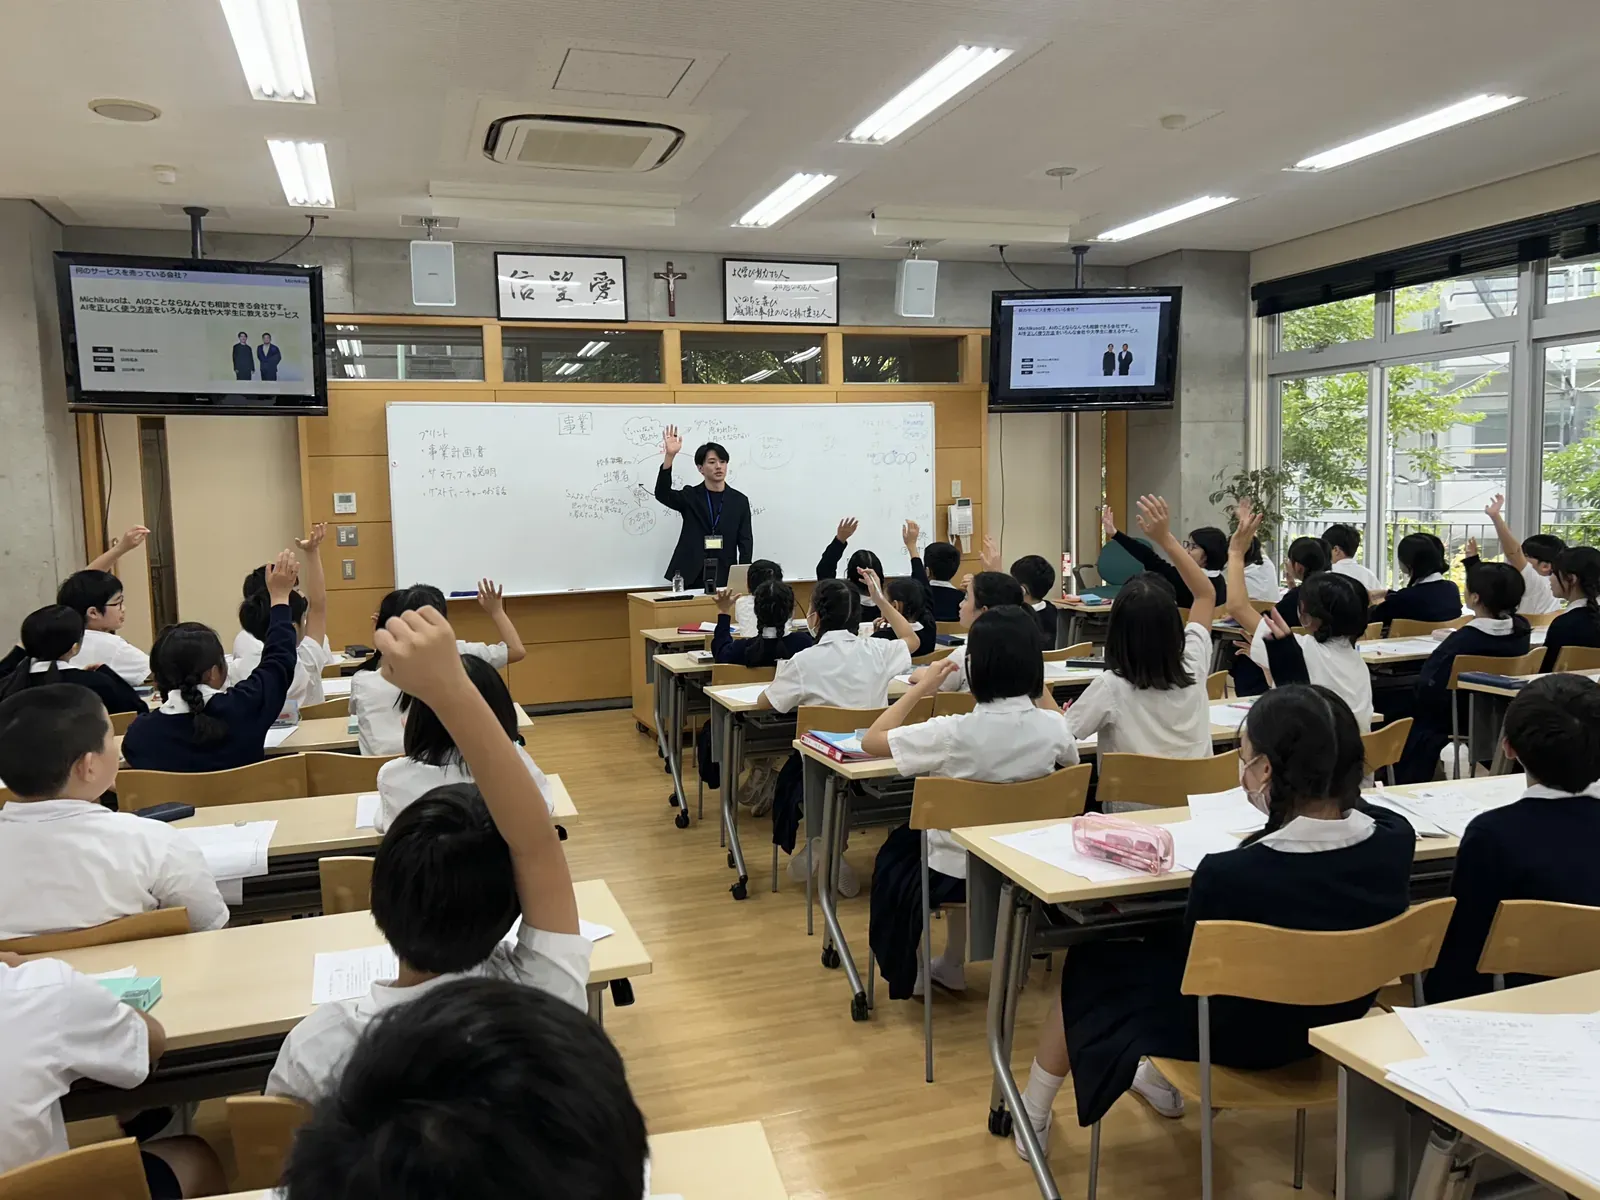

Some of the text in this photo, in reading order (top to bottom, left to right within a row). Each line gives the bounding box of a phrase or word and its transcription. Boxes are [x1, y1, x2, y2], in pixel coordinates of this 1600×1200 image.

[564, 414, 587, 433] 事業
[418, 428, 449, 440] プリント
